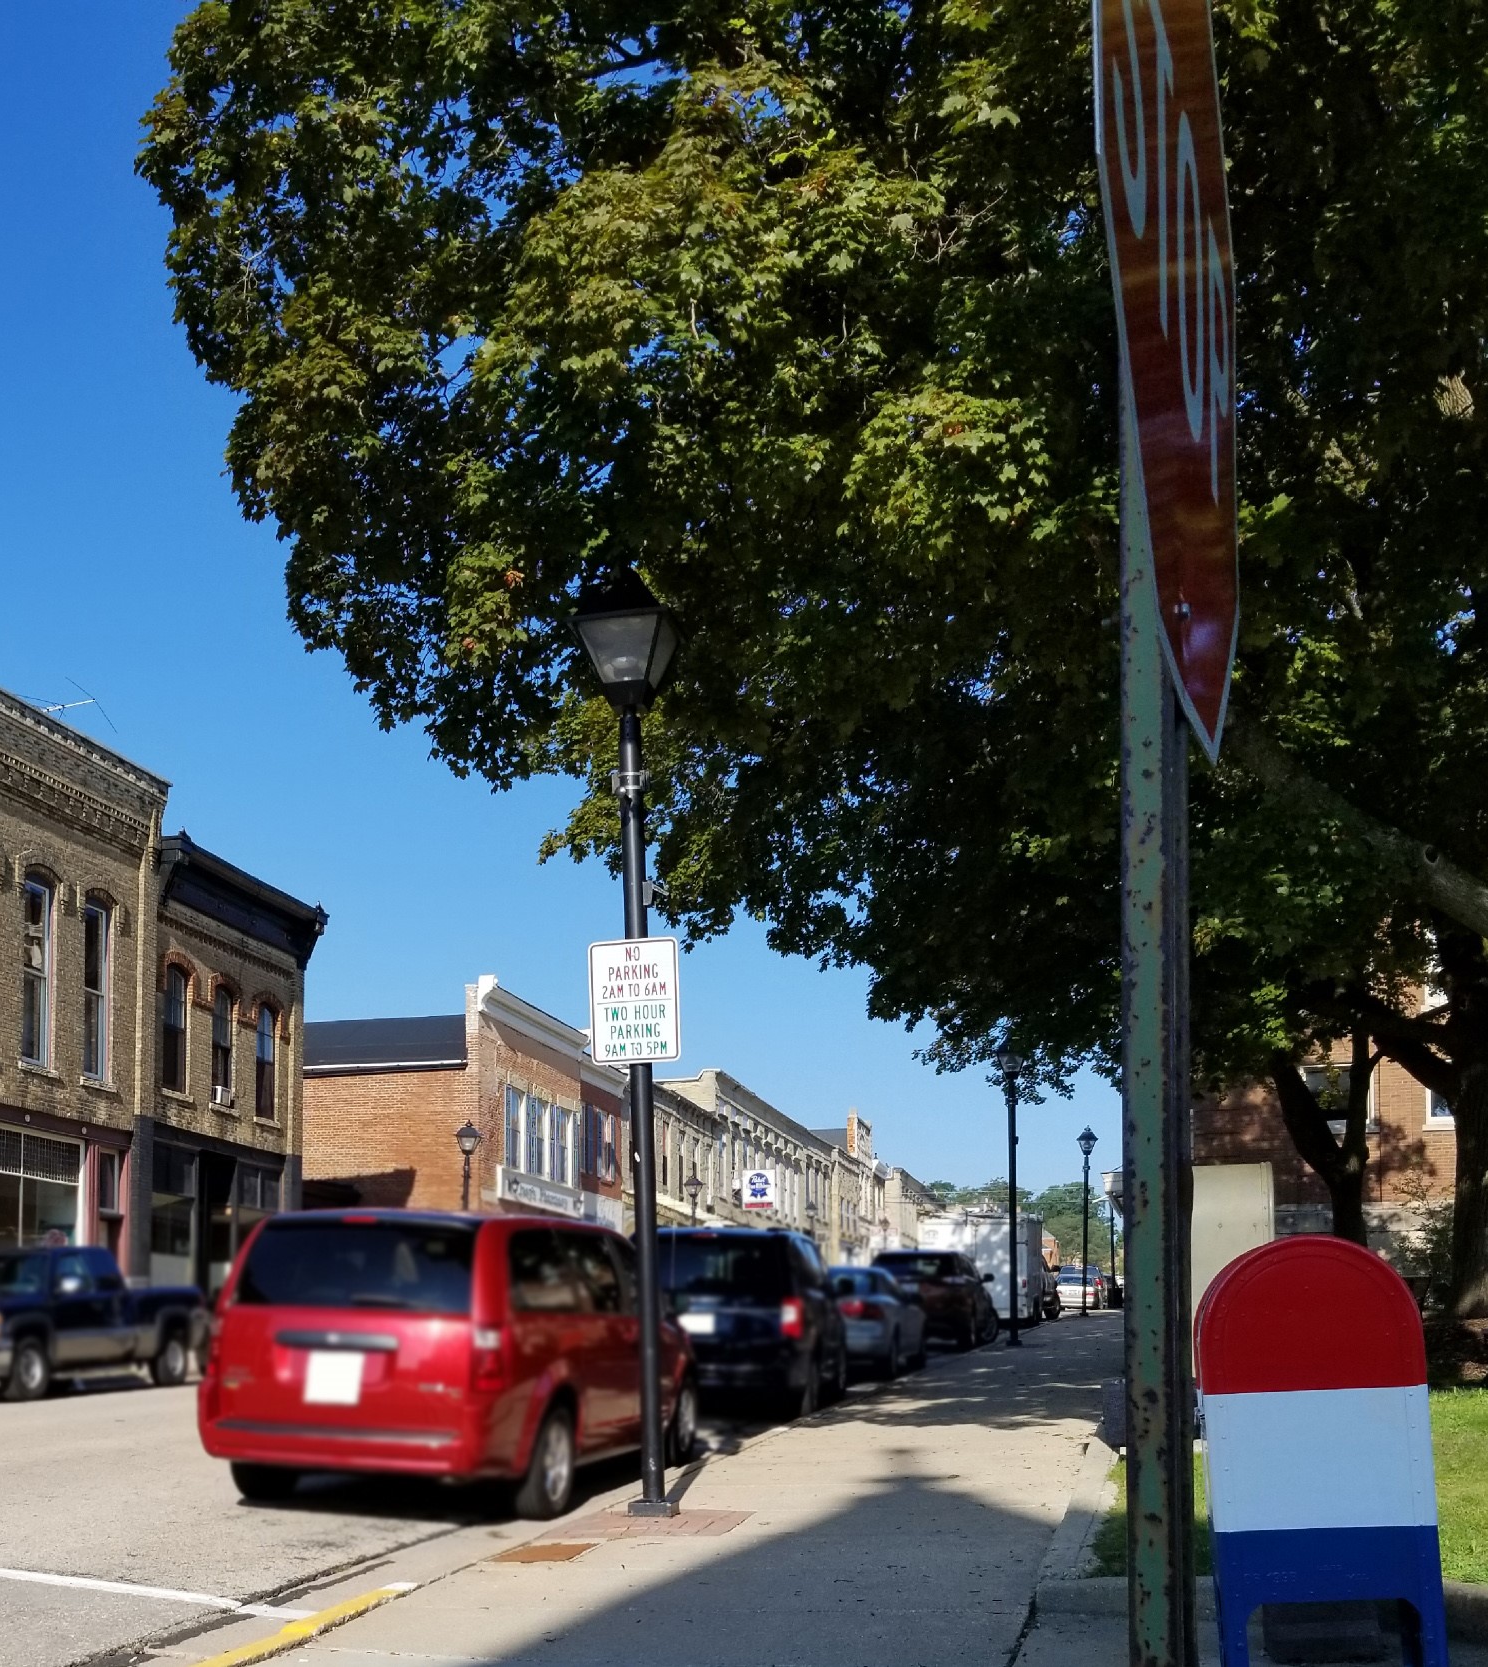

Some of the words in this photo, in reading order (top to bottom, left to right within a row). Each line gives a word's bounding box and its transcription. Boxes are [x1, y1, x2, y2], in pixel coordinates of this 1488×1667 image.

[625, 946, 640, 962] NO
[608, 963, 659, 982] PARKING
[602, 984, 624, 999] 2AM
[628, 983, 640, 997] TO
[644, 981, 667, 996] 6AM
[604, 1006, 628, 1022] TWO
[634, 1004, 666, 1020] HOUR
[610, 1022, 661, 1040] PARKING
[605, 1043, 627, 1057] 9AM
[630, 1042, 642, 1056] TO
[646, 1040, 668, 1055] 5PM
